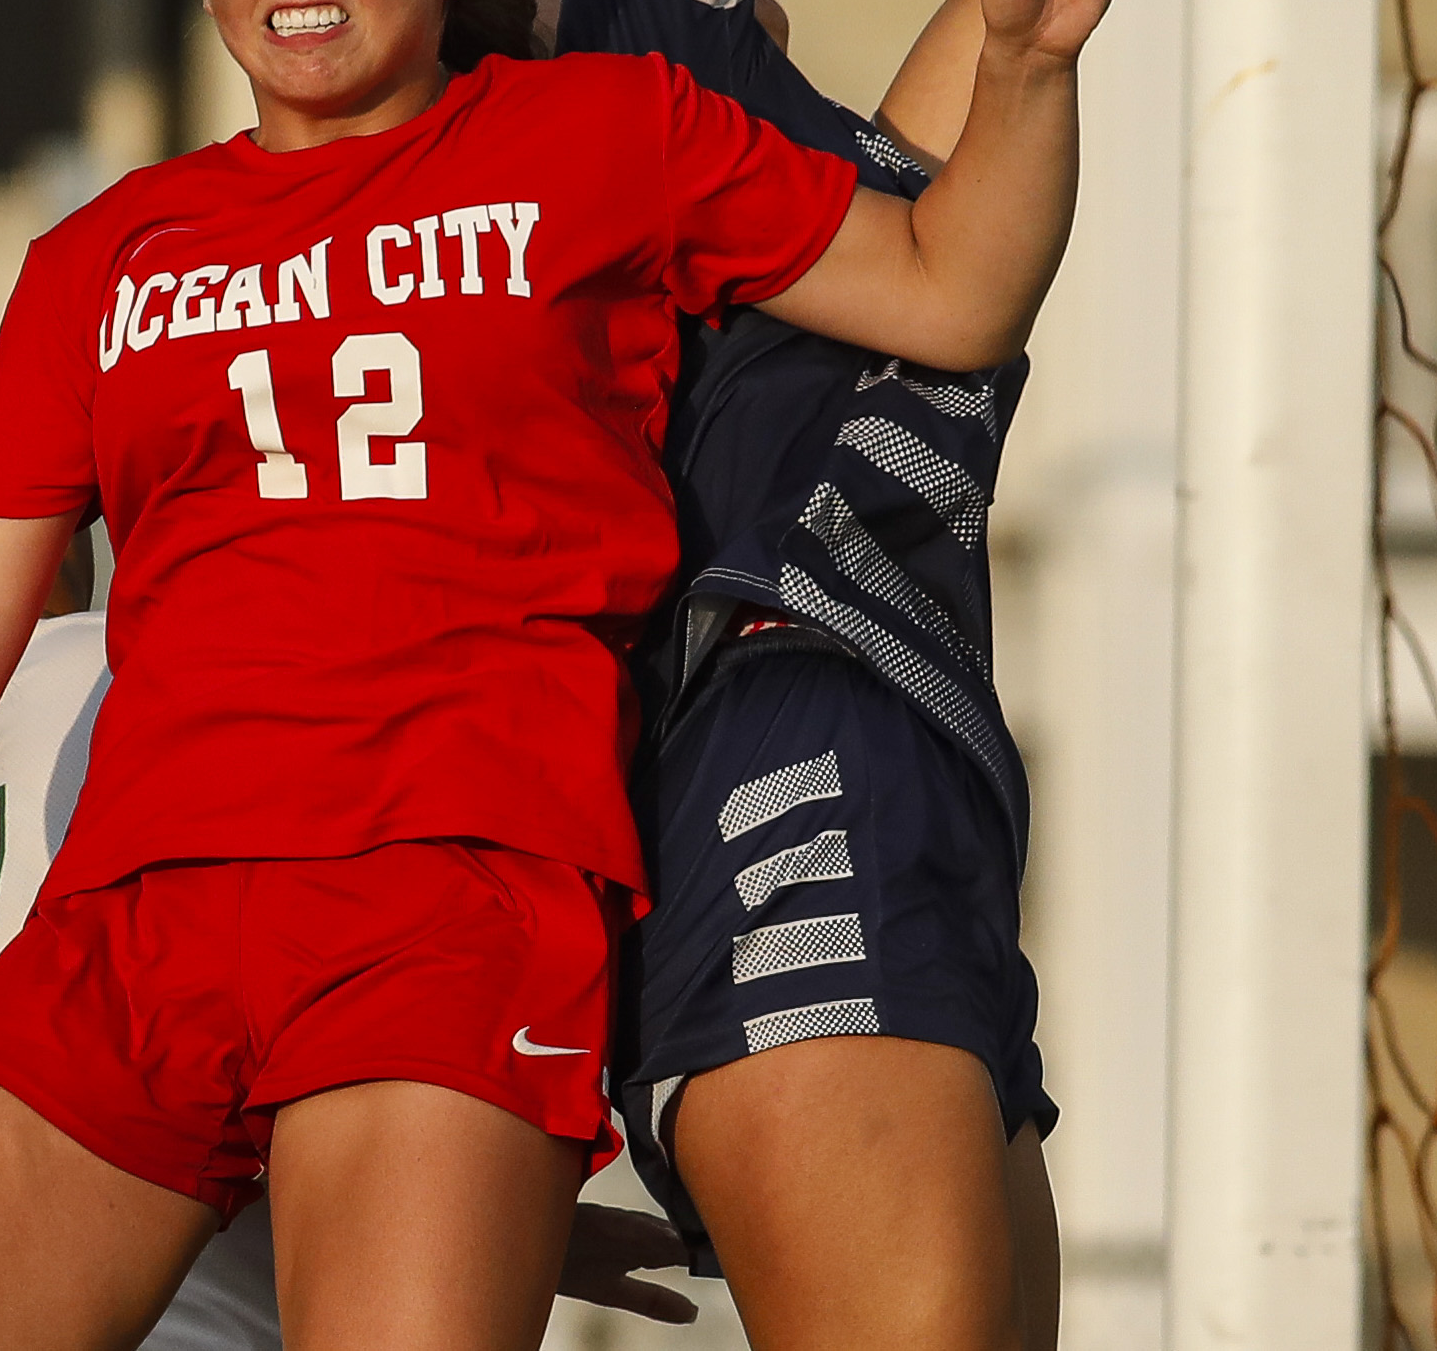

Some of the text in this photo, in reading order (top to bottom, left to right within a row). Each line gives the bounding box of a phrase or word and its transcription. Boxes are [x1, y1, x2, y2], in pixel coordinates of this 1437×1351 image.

[99, 202, 541, 373] OCEAN CITY
[228, 332, 428, 501] 12
